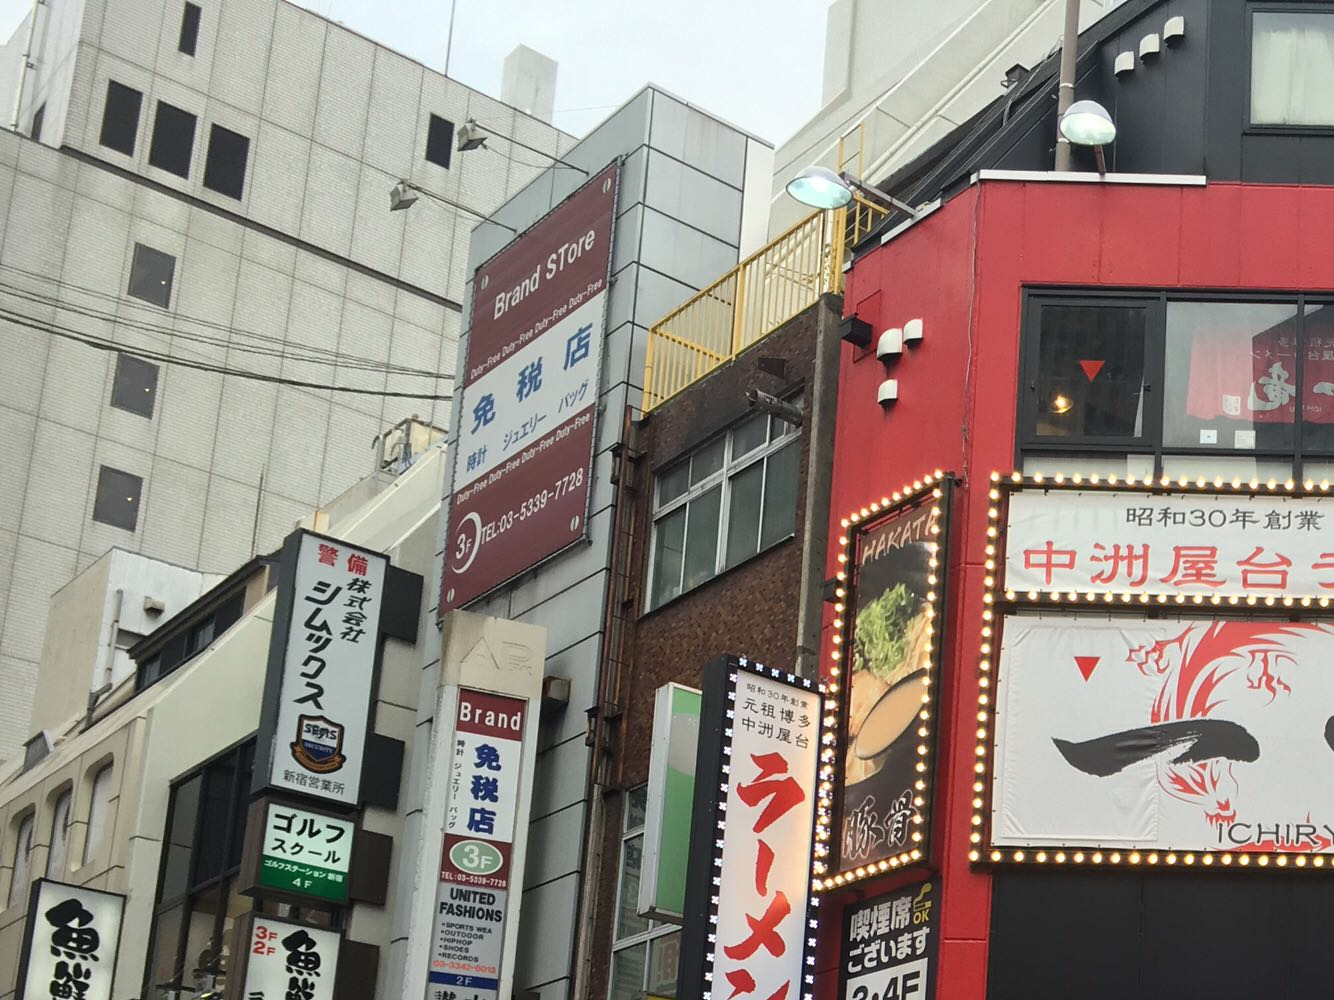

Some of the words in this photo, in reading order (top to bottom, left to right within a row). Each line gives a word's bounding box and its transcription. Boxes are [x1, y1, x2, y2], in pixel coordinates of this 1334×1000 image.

[493, 258, 540, 320] Brand
[545, 229, 596, 278] STore
[470, 352, 501, 379] Duty-Free
[502, 327, 534, 357] Duty-Free
[535, 303, 567, 335] Duty-Free
[568, 278, 603, 311] Duty-Free
[456, 476, 487, 505] Duty-Free
[488, 457, 520, 485] Duty-Free
[521, 434, 555, 463] Duty-Free
[555, 412, 591, 444] Duty-Free
[466, 444, 488, 473] 時計
[503, 412, 547, 452] ジュエリー
[480, 467, 584, 545] TEL:03-5339-7728
[1125, 506, 1326, 532] 昭和30年創業
[456, 533, 472, 560] 3F
[861, 510, 938, 566] HAKATA
[318, 543, 369, 576] 警備
[340, 577, 372, 643] 株式会社
[292, 580, 343, 710] シムックス
[746, 682, 810, 709] 昭和30年創業
[460, 702, 522, 731] Brand
[742, 698, 811, 729] 元祖博多
[741, 716, 810, 750] 中洲屋台
[284, 769, 345, 795] 新宿営業所
[467, 743, 502, 835] 免税店
[272, 813, 345, 844] ゴルフ
[842, 788, 919, 859] 豚骨
[271, 838, 342, 864] スクール
[462, 845, 494, 869] 3F
[439, 902, 503, 922] FASHIONS
[449, 887, 496, 906] UNITED
[255, 926, 277, 942] 3F
[850, 895, 912, 943] 喫煙席
[913, 909, 930, 925] OK
[252, 941, 276, 956] 2F
[847, 926, 932, 974] ございます
[456, 975, 473, 986] 2F
